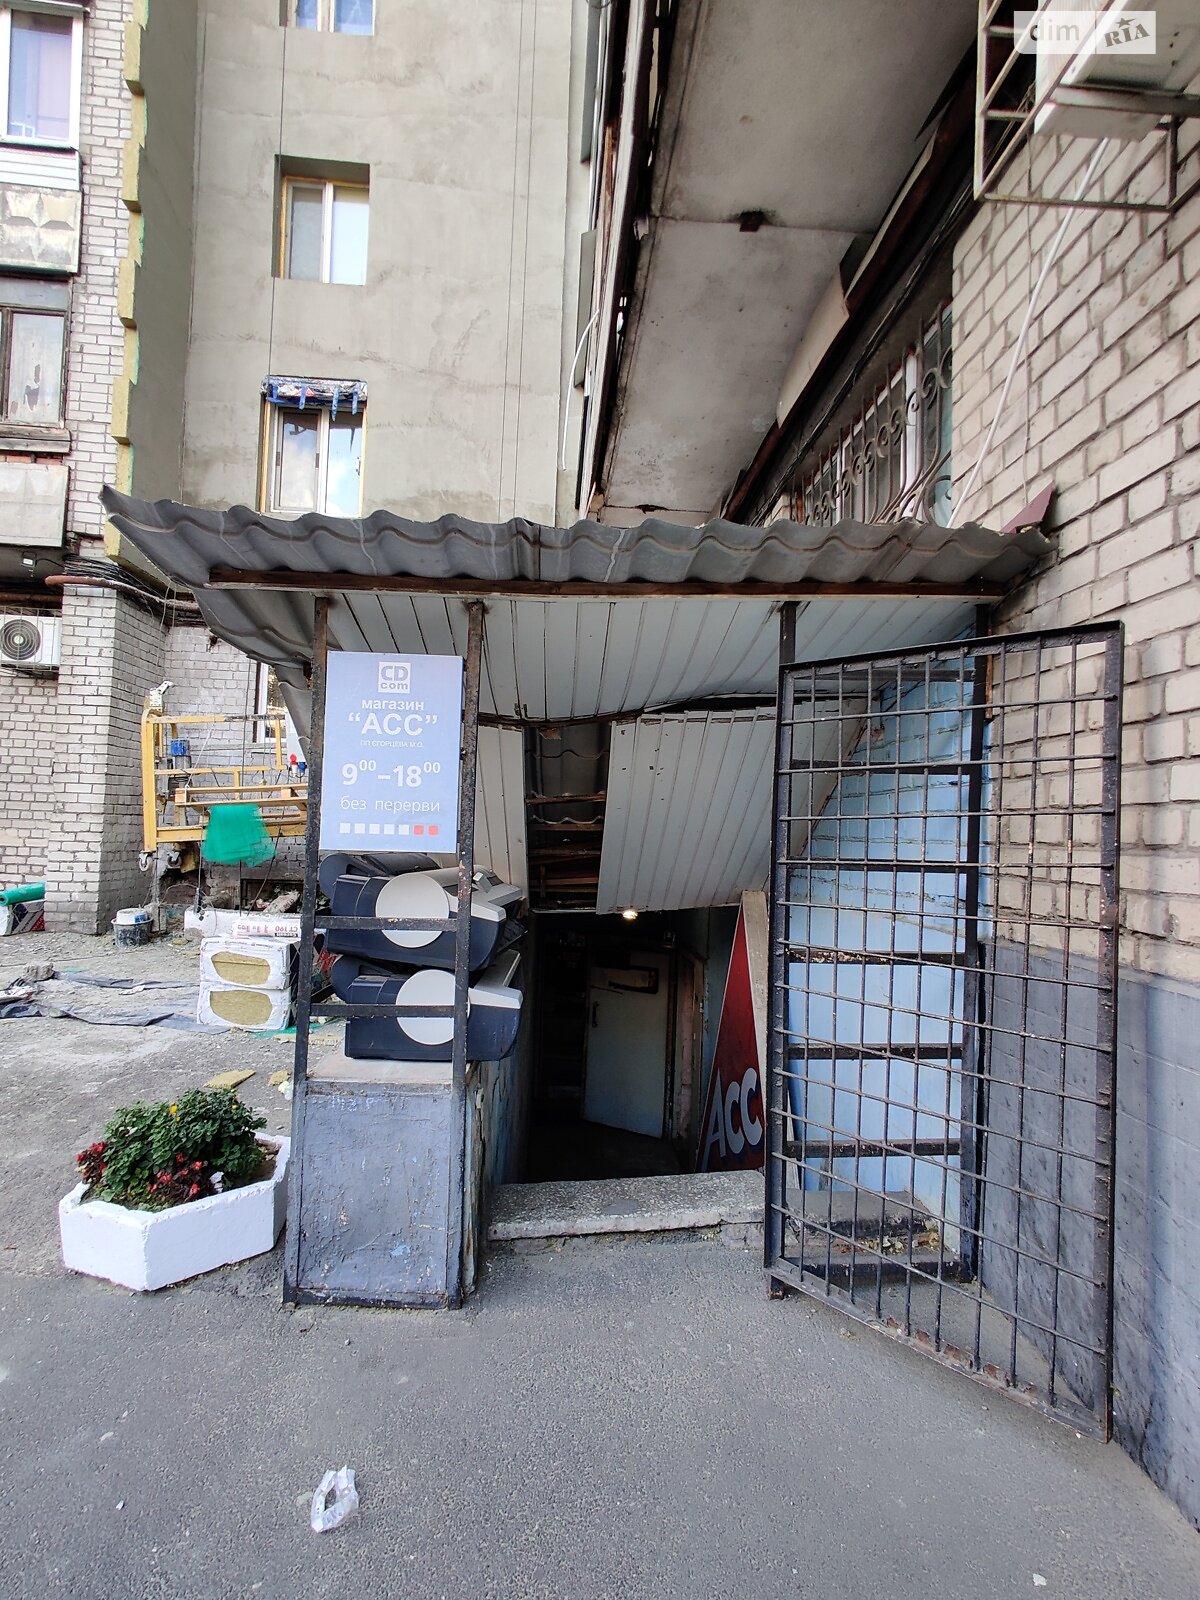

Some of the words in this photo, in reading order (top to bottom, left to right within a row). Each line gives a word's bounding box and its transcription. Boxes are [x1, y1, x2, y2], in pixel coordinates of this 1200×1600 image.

[380, 665, 409, 682] CD
[380, 682, 409, 690] com
[361, 699, 425, 711] магазин
[341, 796, 367, 810] без
[375, 801, 440, 814] перерви
